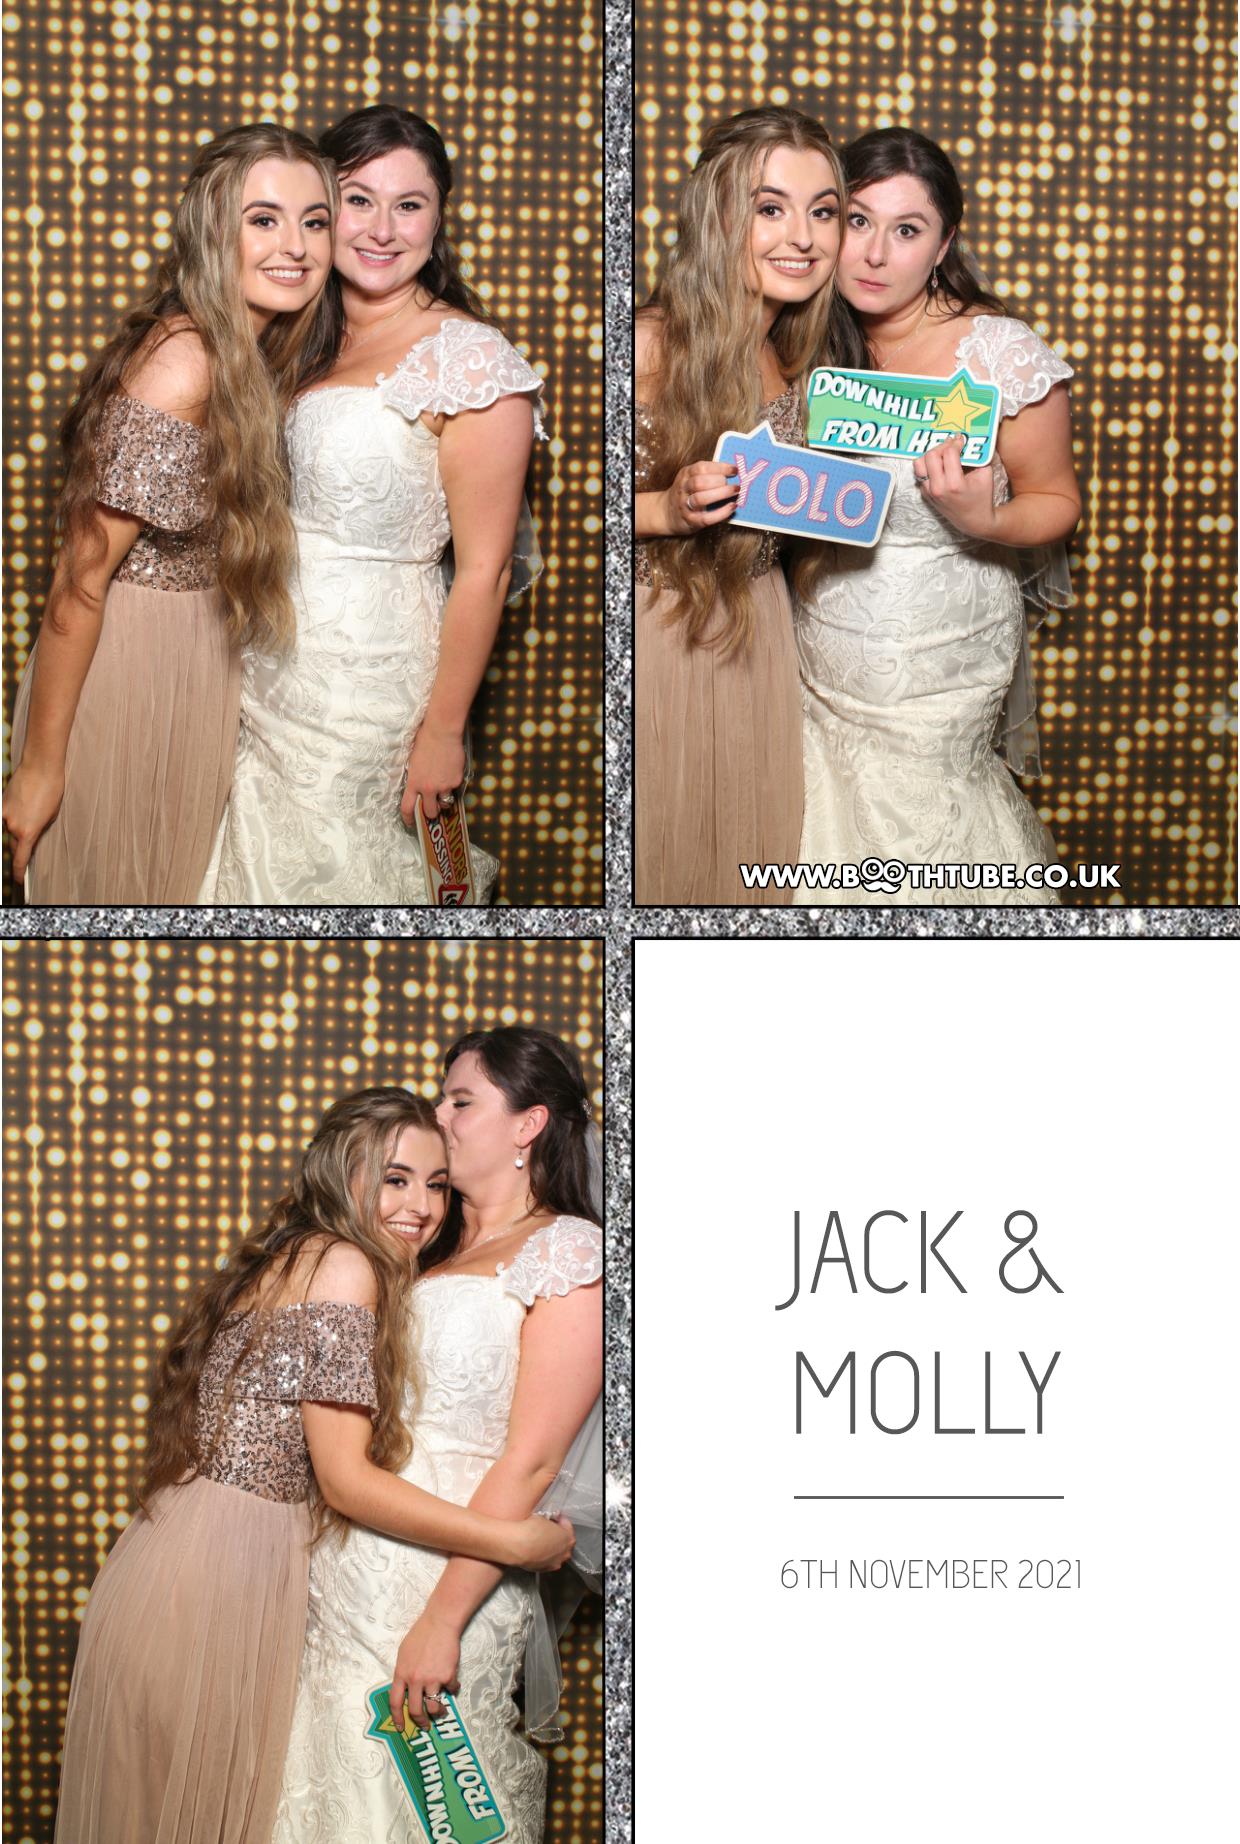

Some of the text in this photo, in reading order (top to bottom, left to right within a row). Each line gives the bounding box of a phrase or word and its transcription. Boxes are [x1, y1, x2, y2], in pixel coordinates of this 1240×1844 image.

[813, 372, 938, 422] DOWNHILL
[822, 420, 988, 460] FROM HEE
[734, 453, 874, 529] YOLO
[429, 822, 453, 885] OSSING
[447, 1744, 496, 1821] FROM
